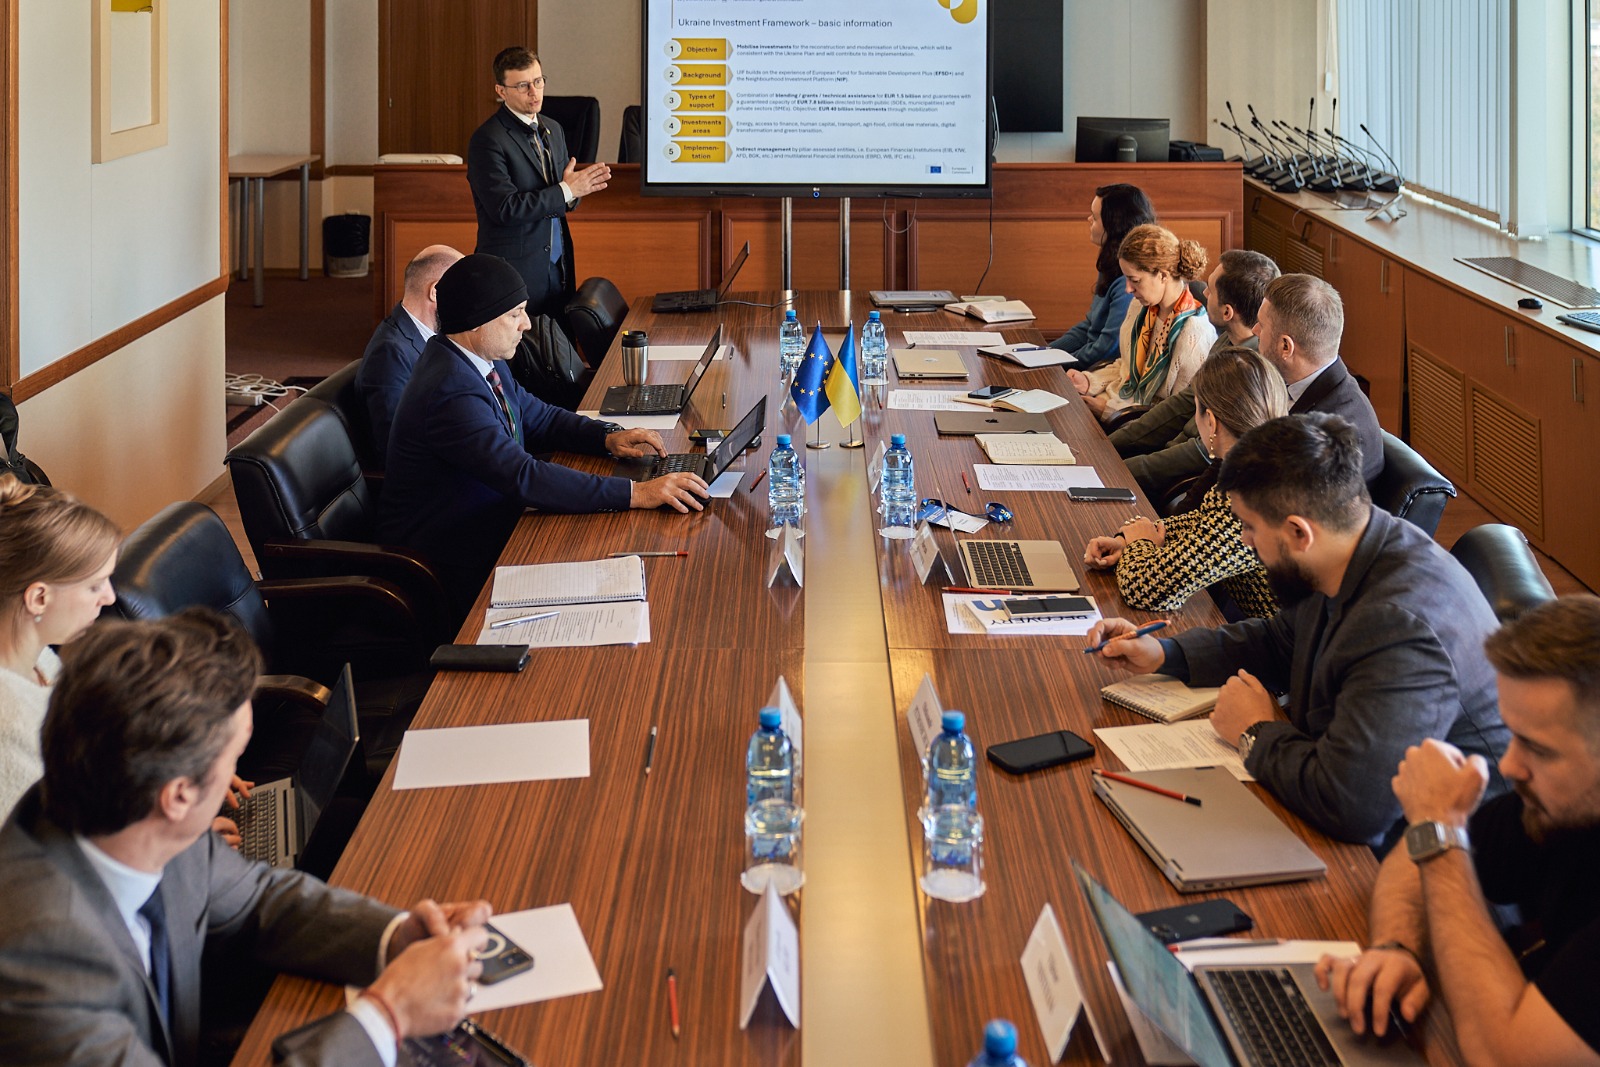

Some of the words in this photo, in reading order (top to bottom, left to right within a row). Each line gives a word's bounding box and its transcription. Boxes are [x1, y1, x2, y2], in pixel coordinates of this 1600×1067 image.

[678, 19, 711, 27] Ukraine
[712, 19, 760, 27] Investment
[762, 19, 810, 27] Framework
[818, 19, 841, 27] basic
[843, 19, 892, 27] information
